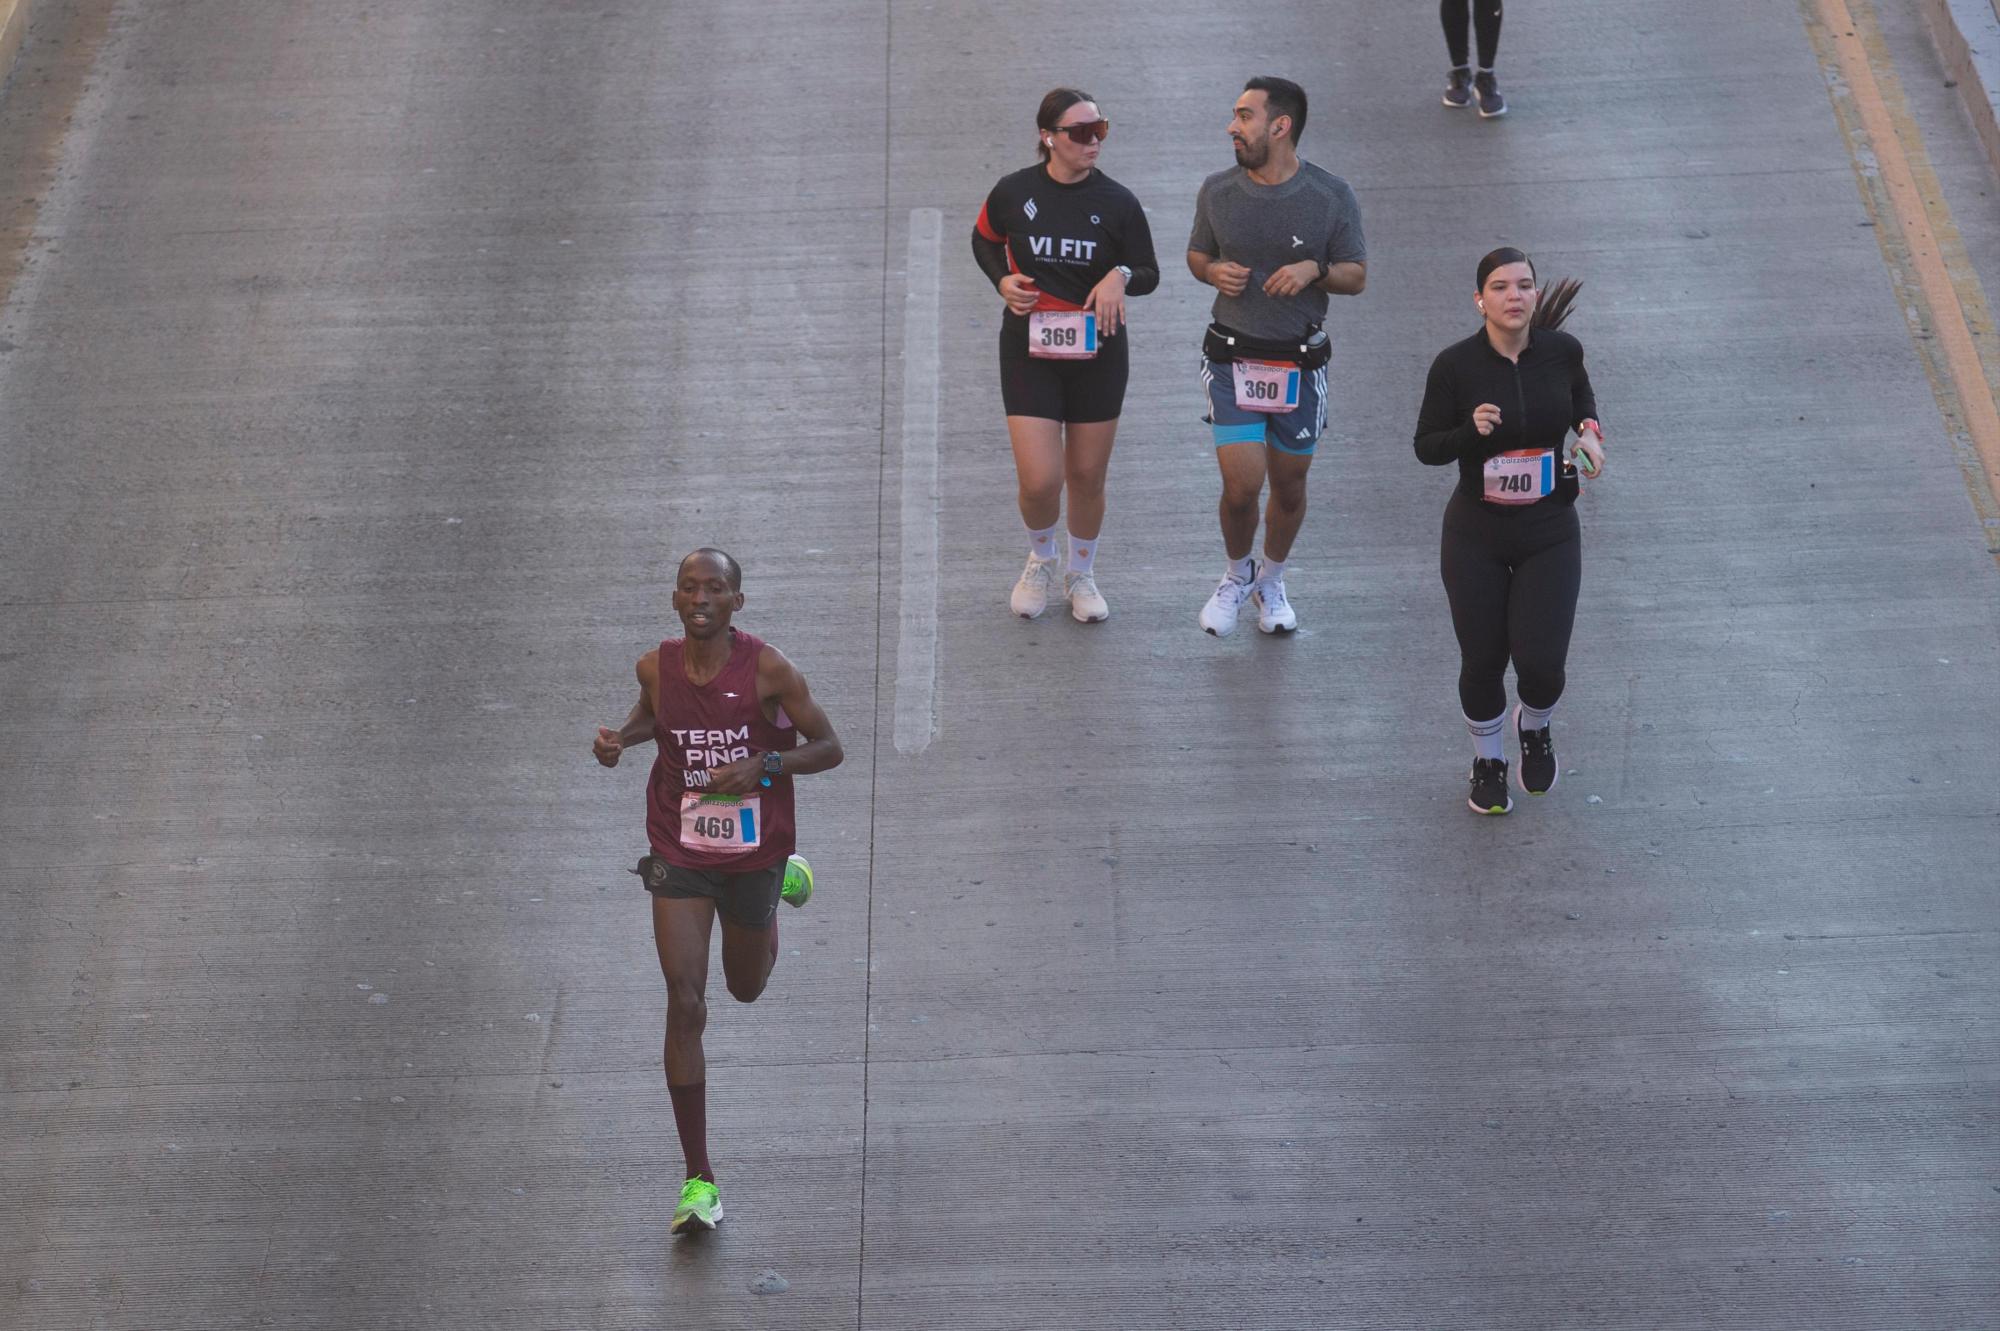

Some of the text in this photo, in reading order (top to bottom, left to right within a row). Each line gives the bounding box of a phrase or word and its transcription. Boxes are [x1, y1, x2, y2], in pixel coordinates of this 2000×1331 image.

[1028, 235, 1097, 260] VI FIT
[1041, 327, 1077, 347] 369
[1244, 380, 1279, 400] 360
[1498, 473, 1532, 493] 740
[670, 725, 749, 746] TEAM
[686, 745, 749, 767] PIÑA
[683, 769, 711, 788] BON
[694, 816, 735, 839] 469
